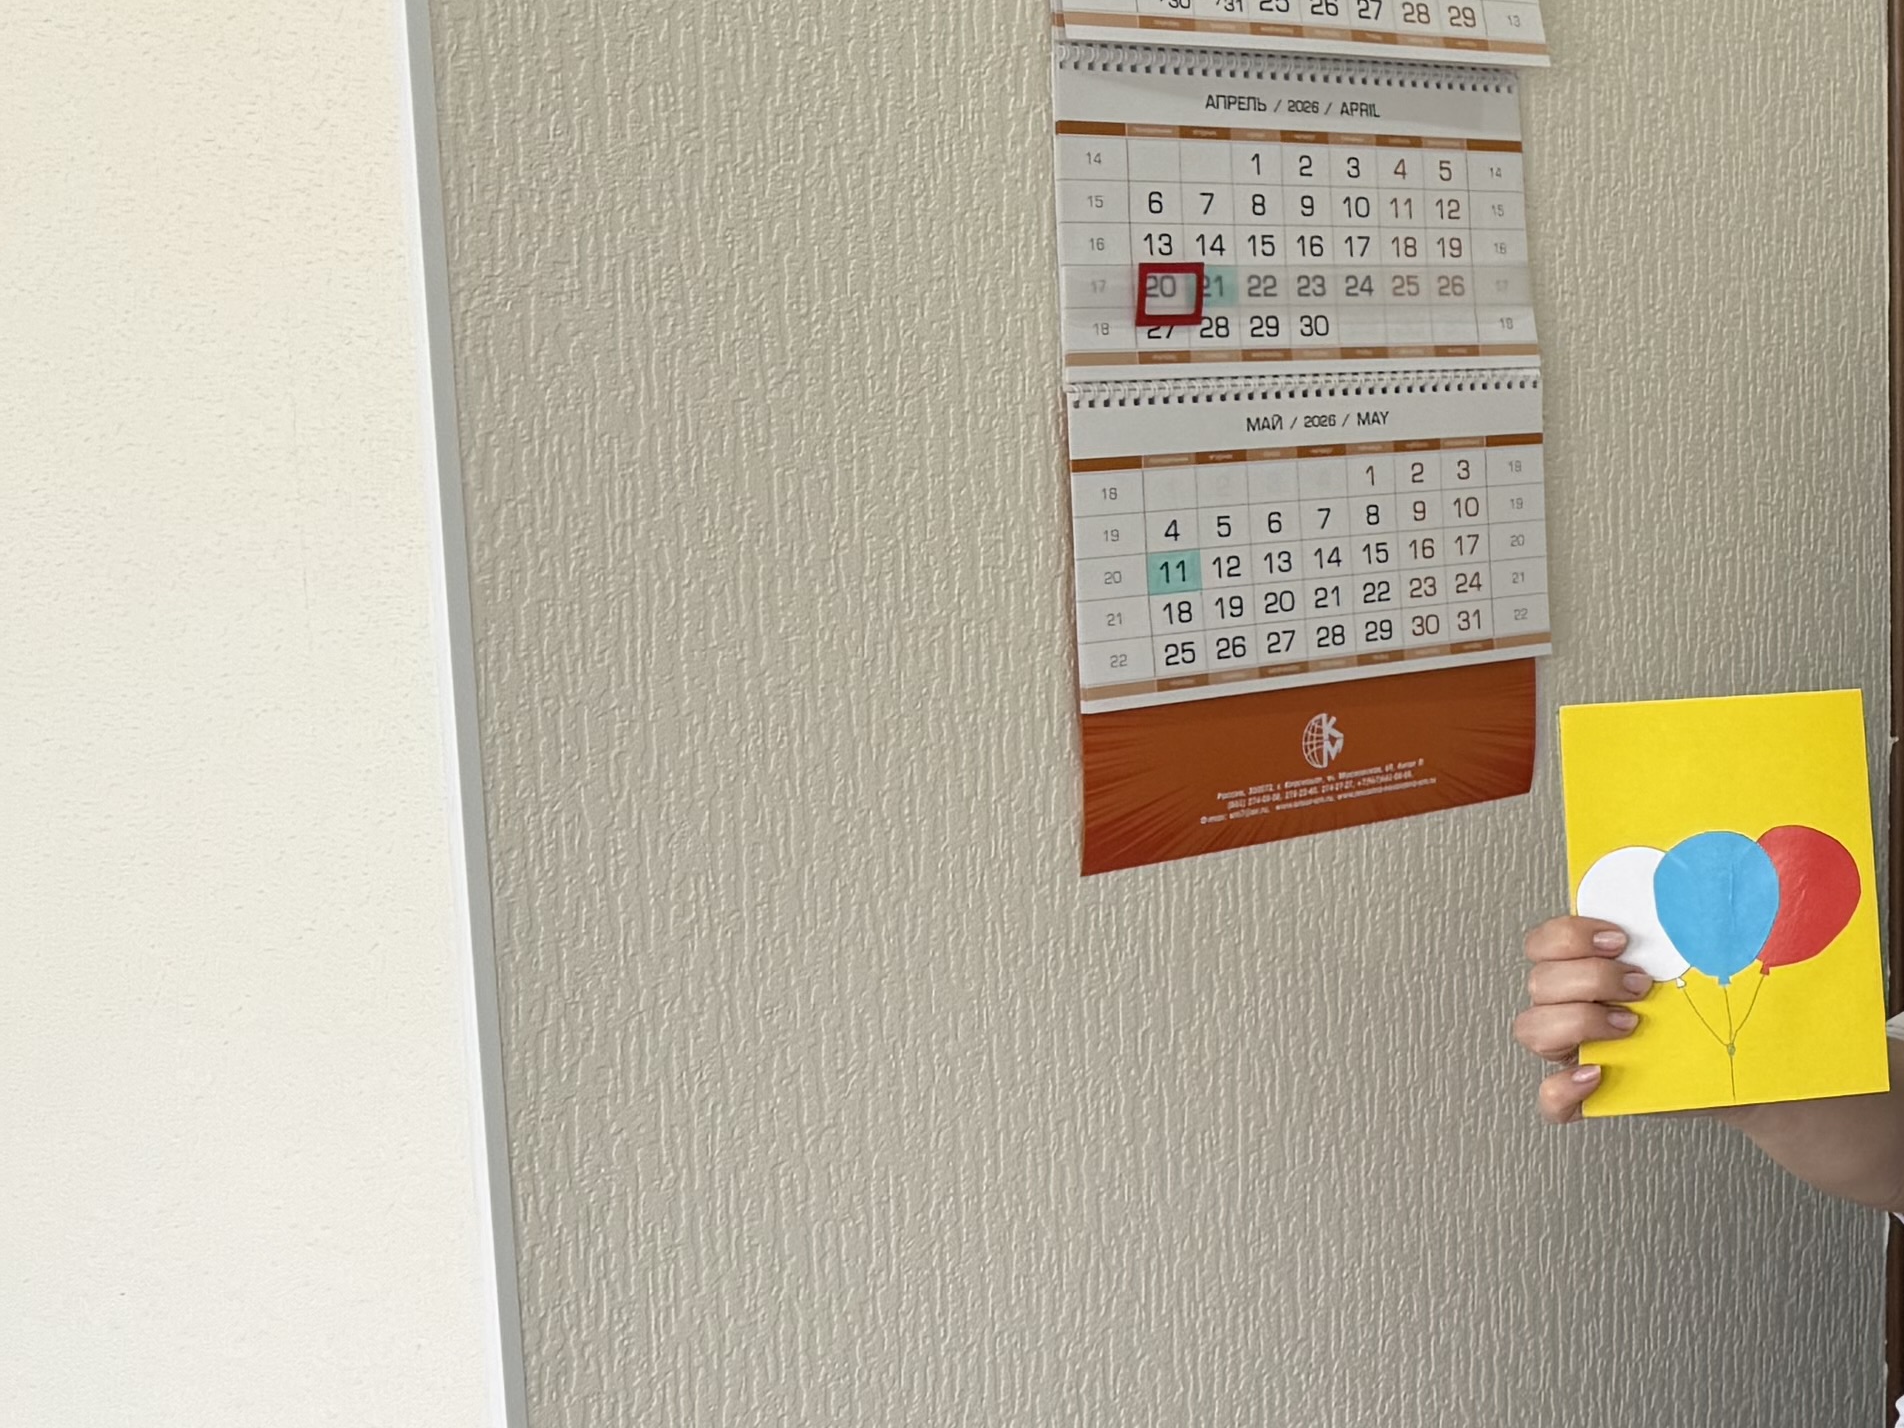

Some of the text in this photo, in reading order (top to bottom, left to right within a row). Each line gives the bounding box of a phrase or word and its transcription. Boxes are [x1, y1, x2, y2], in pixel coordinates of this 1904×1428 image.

[1401, 1, 1431, 25] 28
[1447, 5, 1477, 29] 29
[1205, 94, 1381, 119] АПРЕЛЬ 2026 APRIL
[1251, 152, 1453, 182] 1 2 3 4 5
[1148, 191, 1461, 221] 6 7 8 9 10 11 12
[1143, 232, 1463, 259] 13 14 15 16 17 18 19
[1145, 275, 1177, 299] 20
[1247, 274, 1278, 298] 22
[1296, 274, 1327, 298] 23
[1345, 274, 1374, 297] 24
[1391, 274, 1420, 297] 25
[1437, 274, 1466, 297] 26
[1199, 316, 1230, 339] 28
[1249, 314, 1280, 338] 29
[1299, 314, 1330, 337] 30
[1246, 410, 1390, 432] МАЙ 2026 MAY
[1365, 459, 1471, 486] 1 2 3
[1164, 496, 1480, 542] 4 5 6 7 8 9 10
[1159, 533, 1480, 584] 11 12 13 14 15 16 17
[1162, 571, 1483, 625] 18 19 20 21 22 23 24
[1164, 641, 1196, 667] 25
[1215, 635, 1247, 660] 26
[1266, 629, 1296, 654] 27
[1316, 624, 1346, 649] 28
[1364, 618, 1393, 643] 29
[1411, 613, 1440, 637] 30
[1456, 608, 1482, 632] 31
